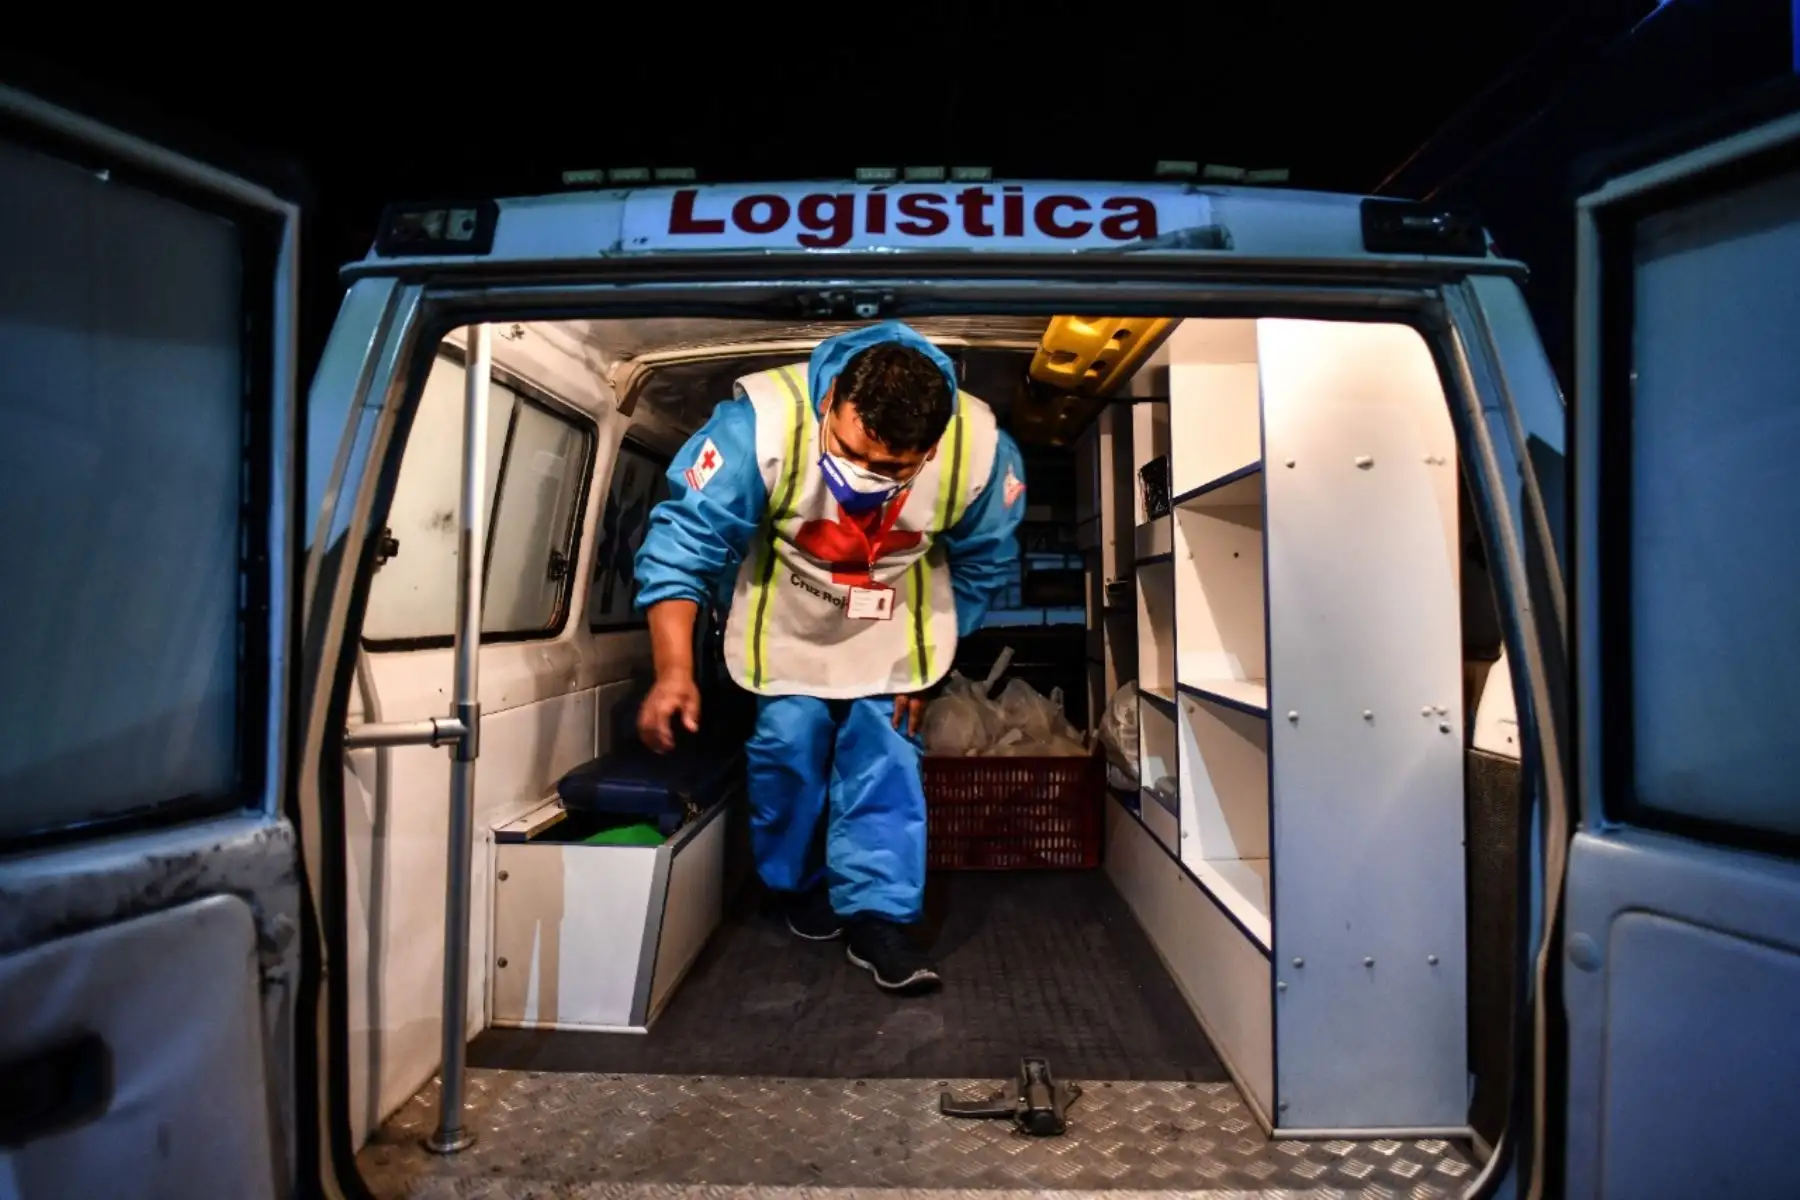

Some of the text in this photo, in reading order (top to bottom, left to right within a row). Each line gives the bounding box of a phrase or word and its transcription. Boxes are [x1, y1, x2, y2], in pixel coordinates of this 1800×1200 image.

[667, 184, 1160, 249] Logística
[790, 573, 821, 597] Cruz
[822, 591, 849, 610] Roj
